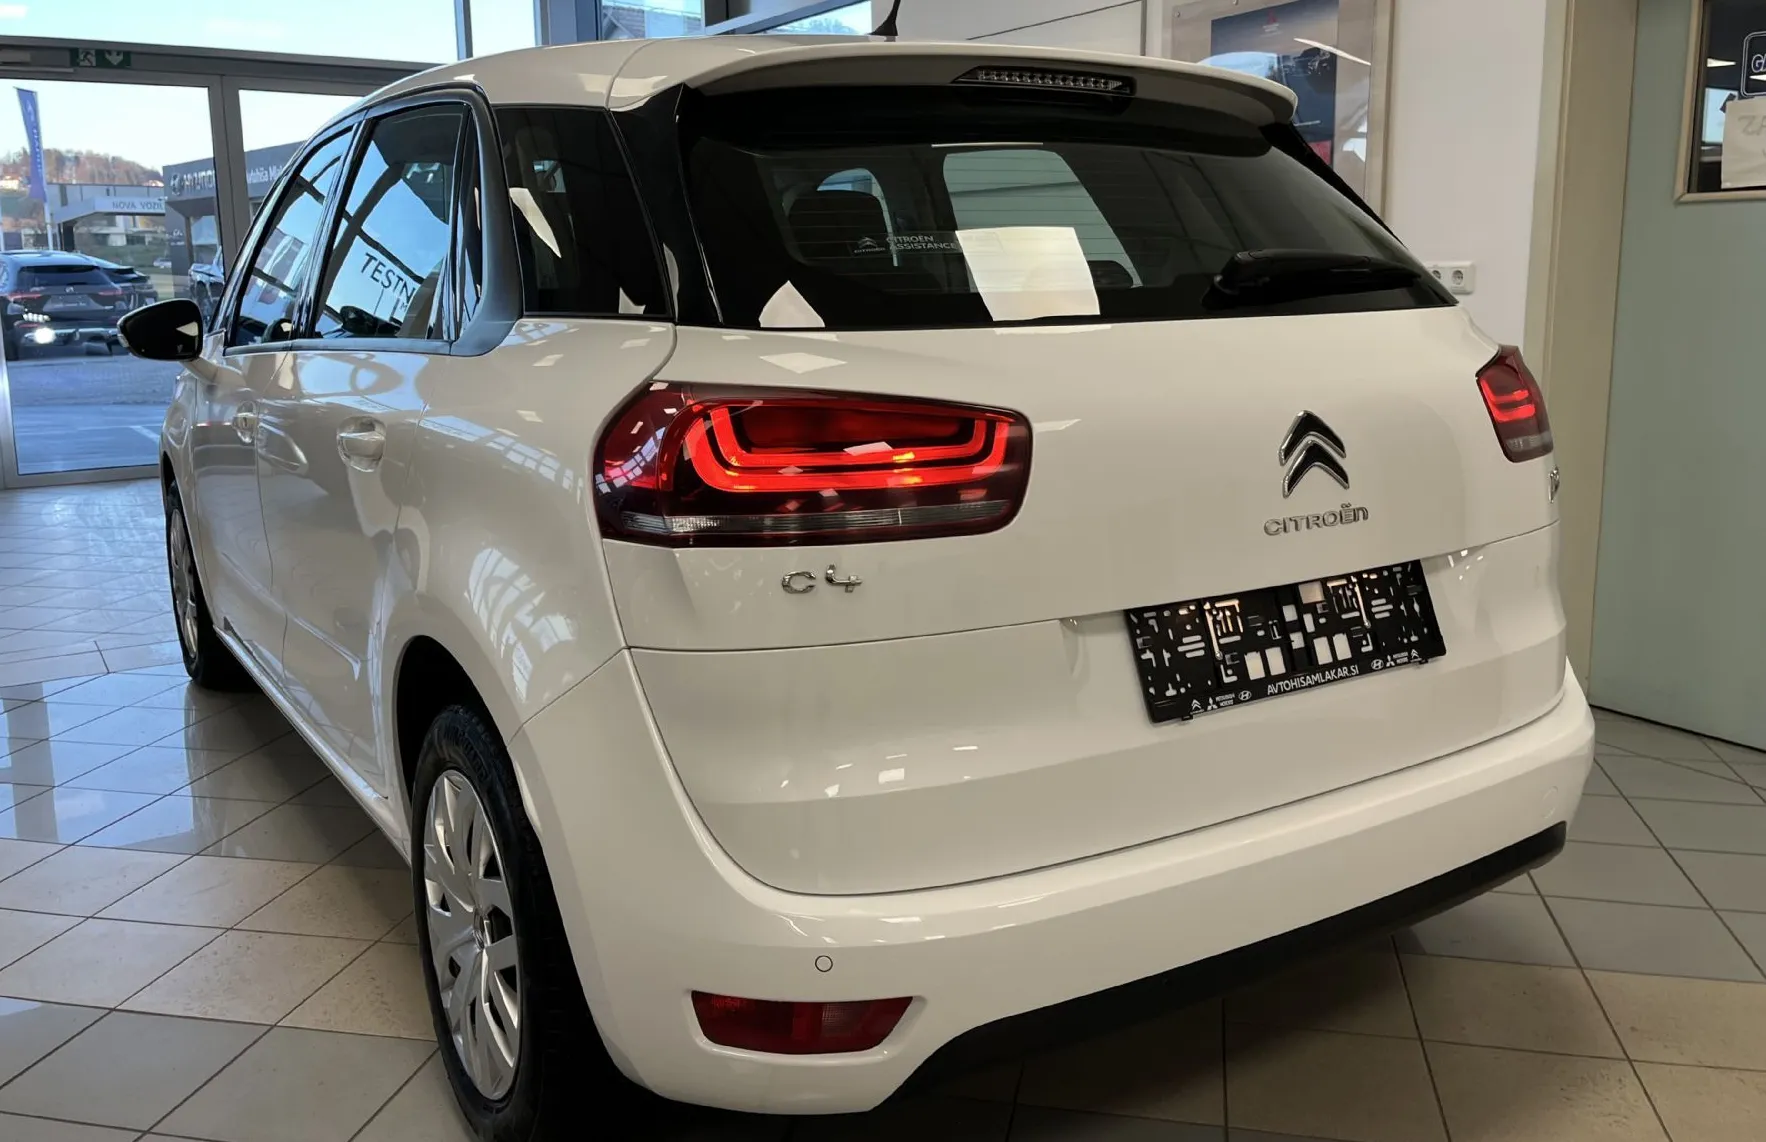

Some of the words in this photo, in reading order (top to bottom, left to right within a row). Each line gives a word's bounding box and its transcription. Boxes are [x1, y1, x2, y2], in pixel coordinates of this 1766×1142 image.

[112, 201, 137, 210] NOVA
[889, 242, 957, 250] ASSISTANCE
[781, 563, 863, 594] C4
[1266, 664, 1360, 695] AVTOHISAMLAKAR.SI
